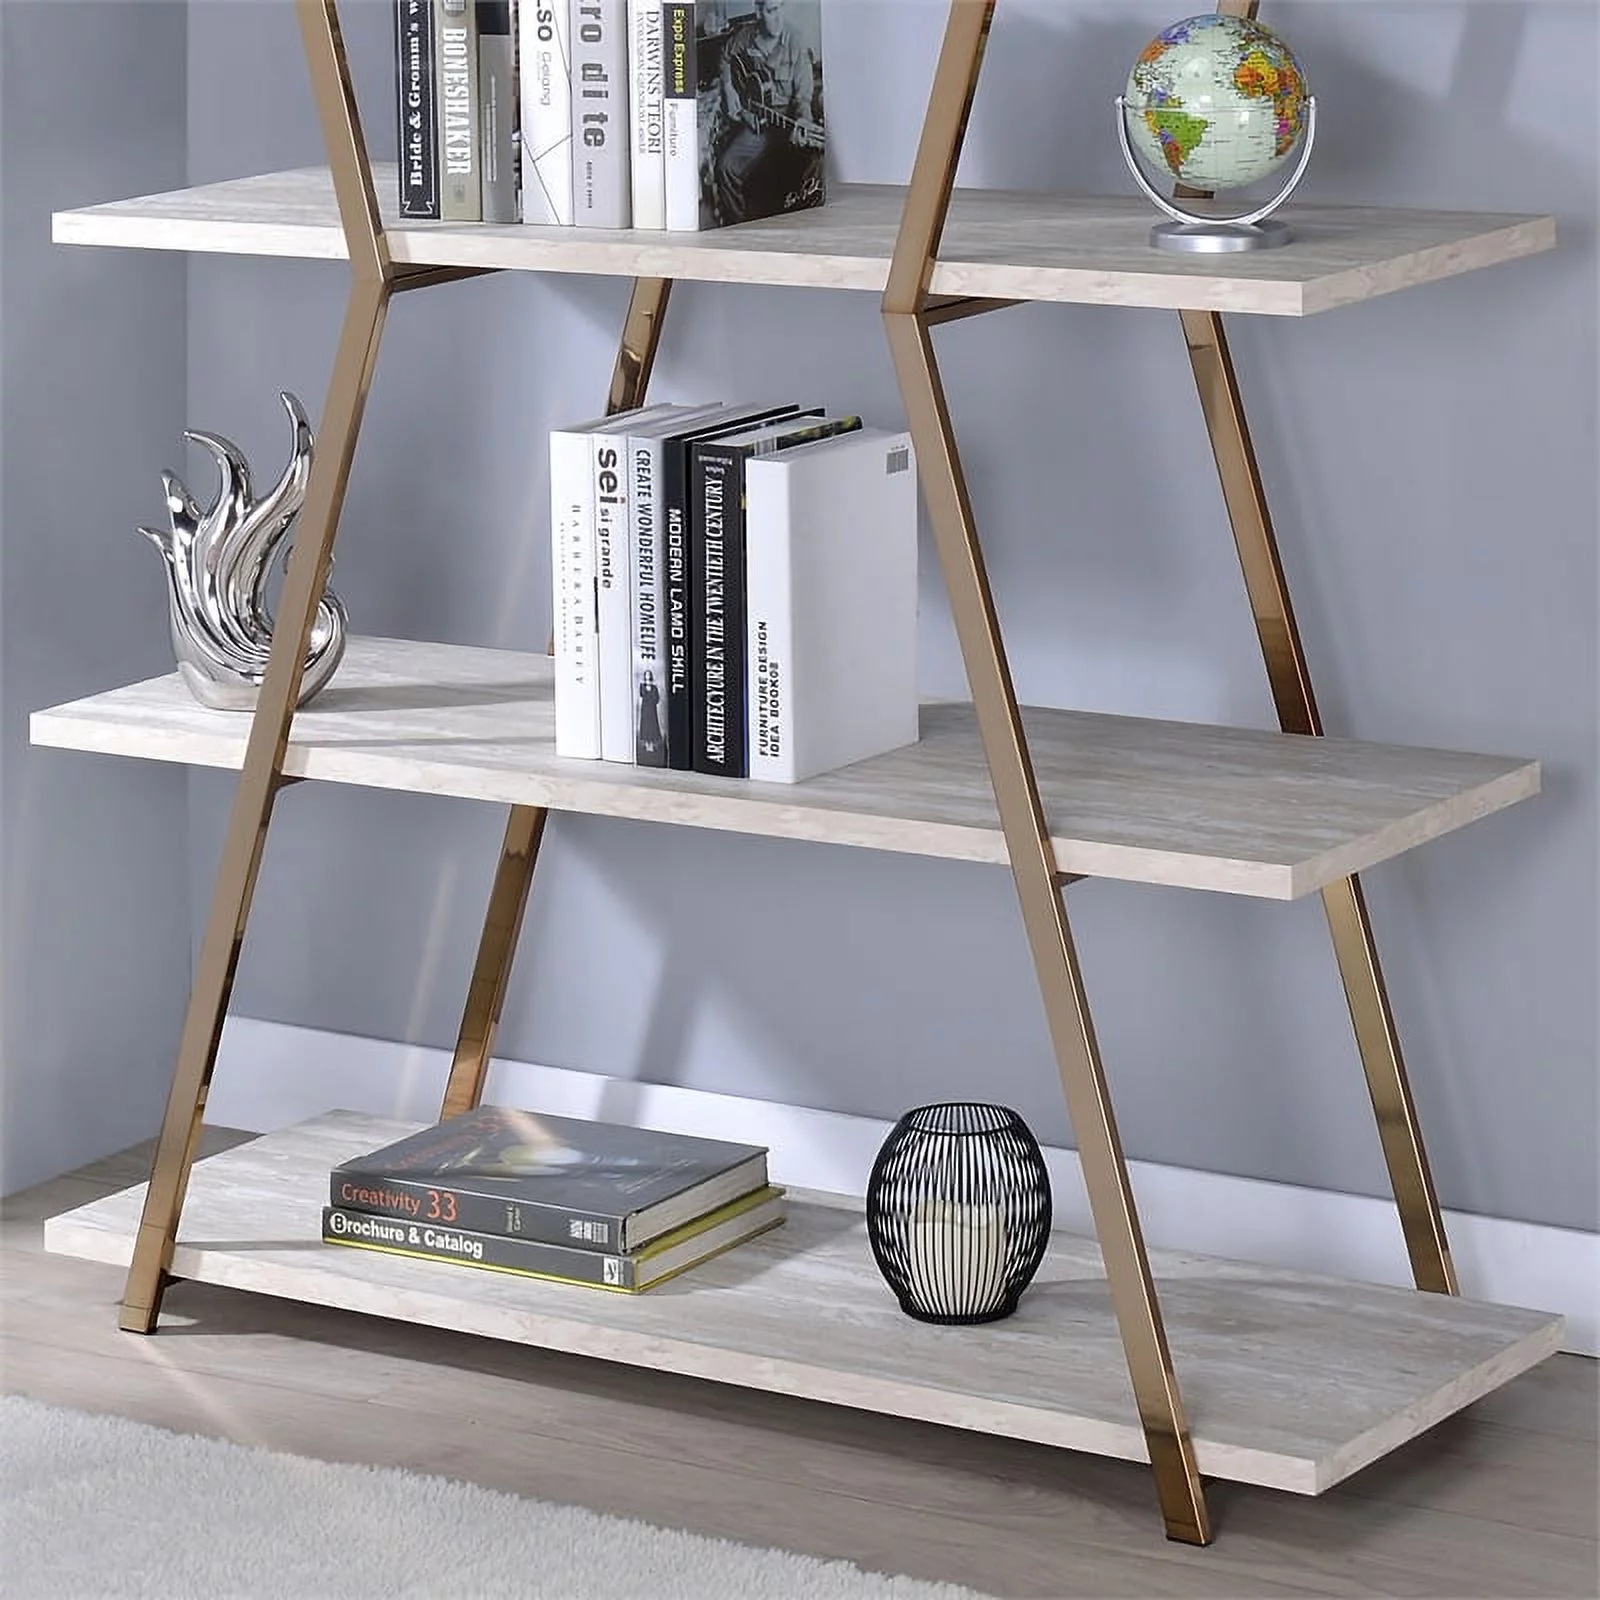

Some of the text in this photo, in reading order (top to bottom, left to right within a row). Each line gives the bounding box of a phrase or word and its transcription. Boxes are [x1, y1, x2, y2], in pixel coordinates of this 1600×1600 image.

[580, 0, 602, 43] ro
[672, 9, 685, 94] Expo Express
[443, 27, 472, 174] BONESHAKER
[646, 11, 662, 154] DARWINS TEORI
[409, 111, 421, 129] &
[583, 112, 609, 147] te
[410, 133, 423, 186] Bride
[598, 448, 627, 504] sei
[705, 475, 723, 537] CENTURY
[598, 528, 614, 589] grande
[635, 450, 656, 660] CREATE WONDERFUL HOMELIFE
[668, 508, 685, 583] MODERN
[705, 538, 724, 616] TWENTIETH
[706, 617, 724, 645] THE
[706, 645, 724, 661] IN
[758, 621, 769, 757] FURNITURE DESIGN
[769, 724, 780, 758] IDEA
[341, 1183, 458, 1222] Creativity 33
[330, 1212, 484, 1259] Brochure & Catalog
